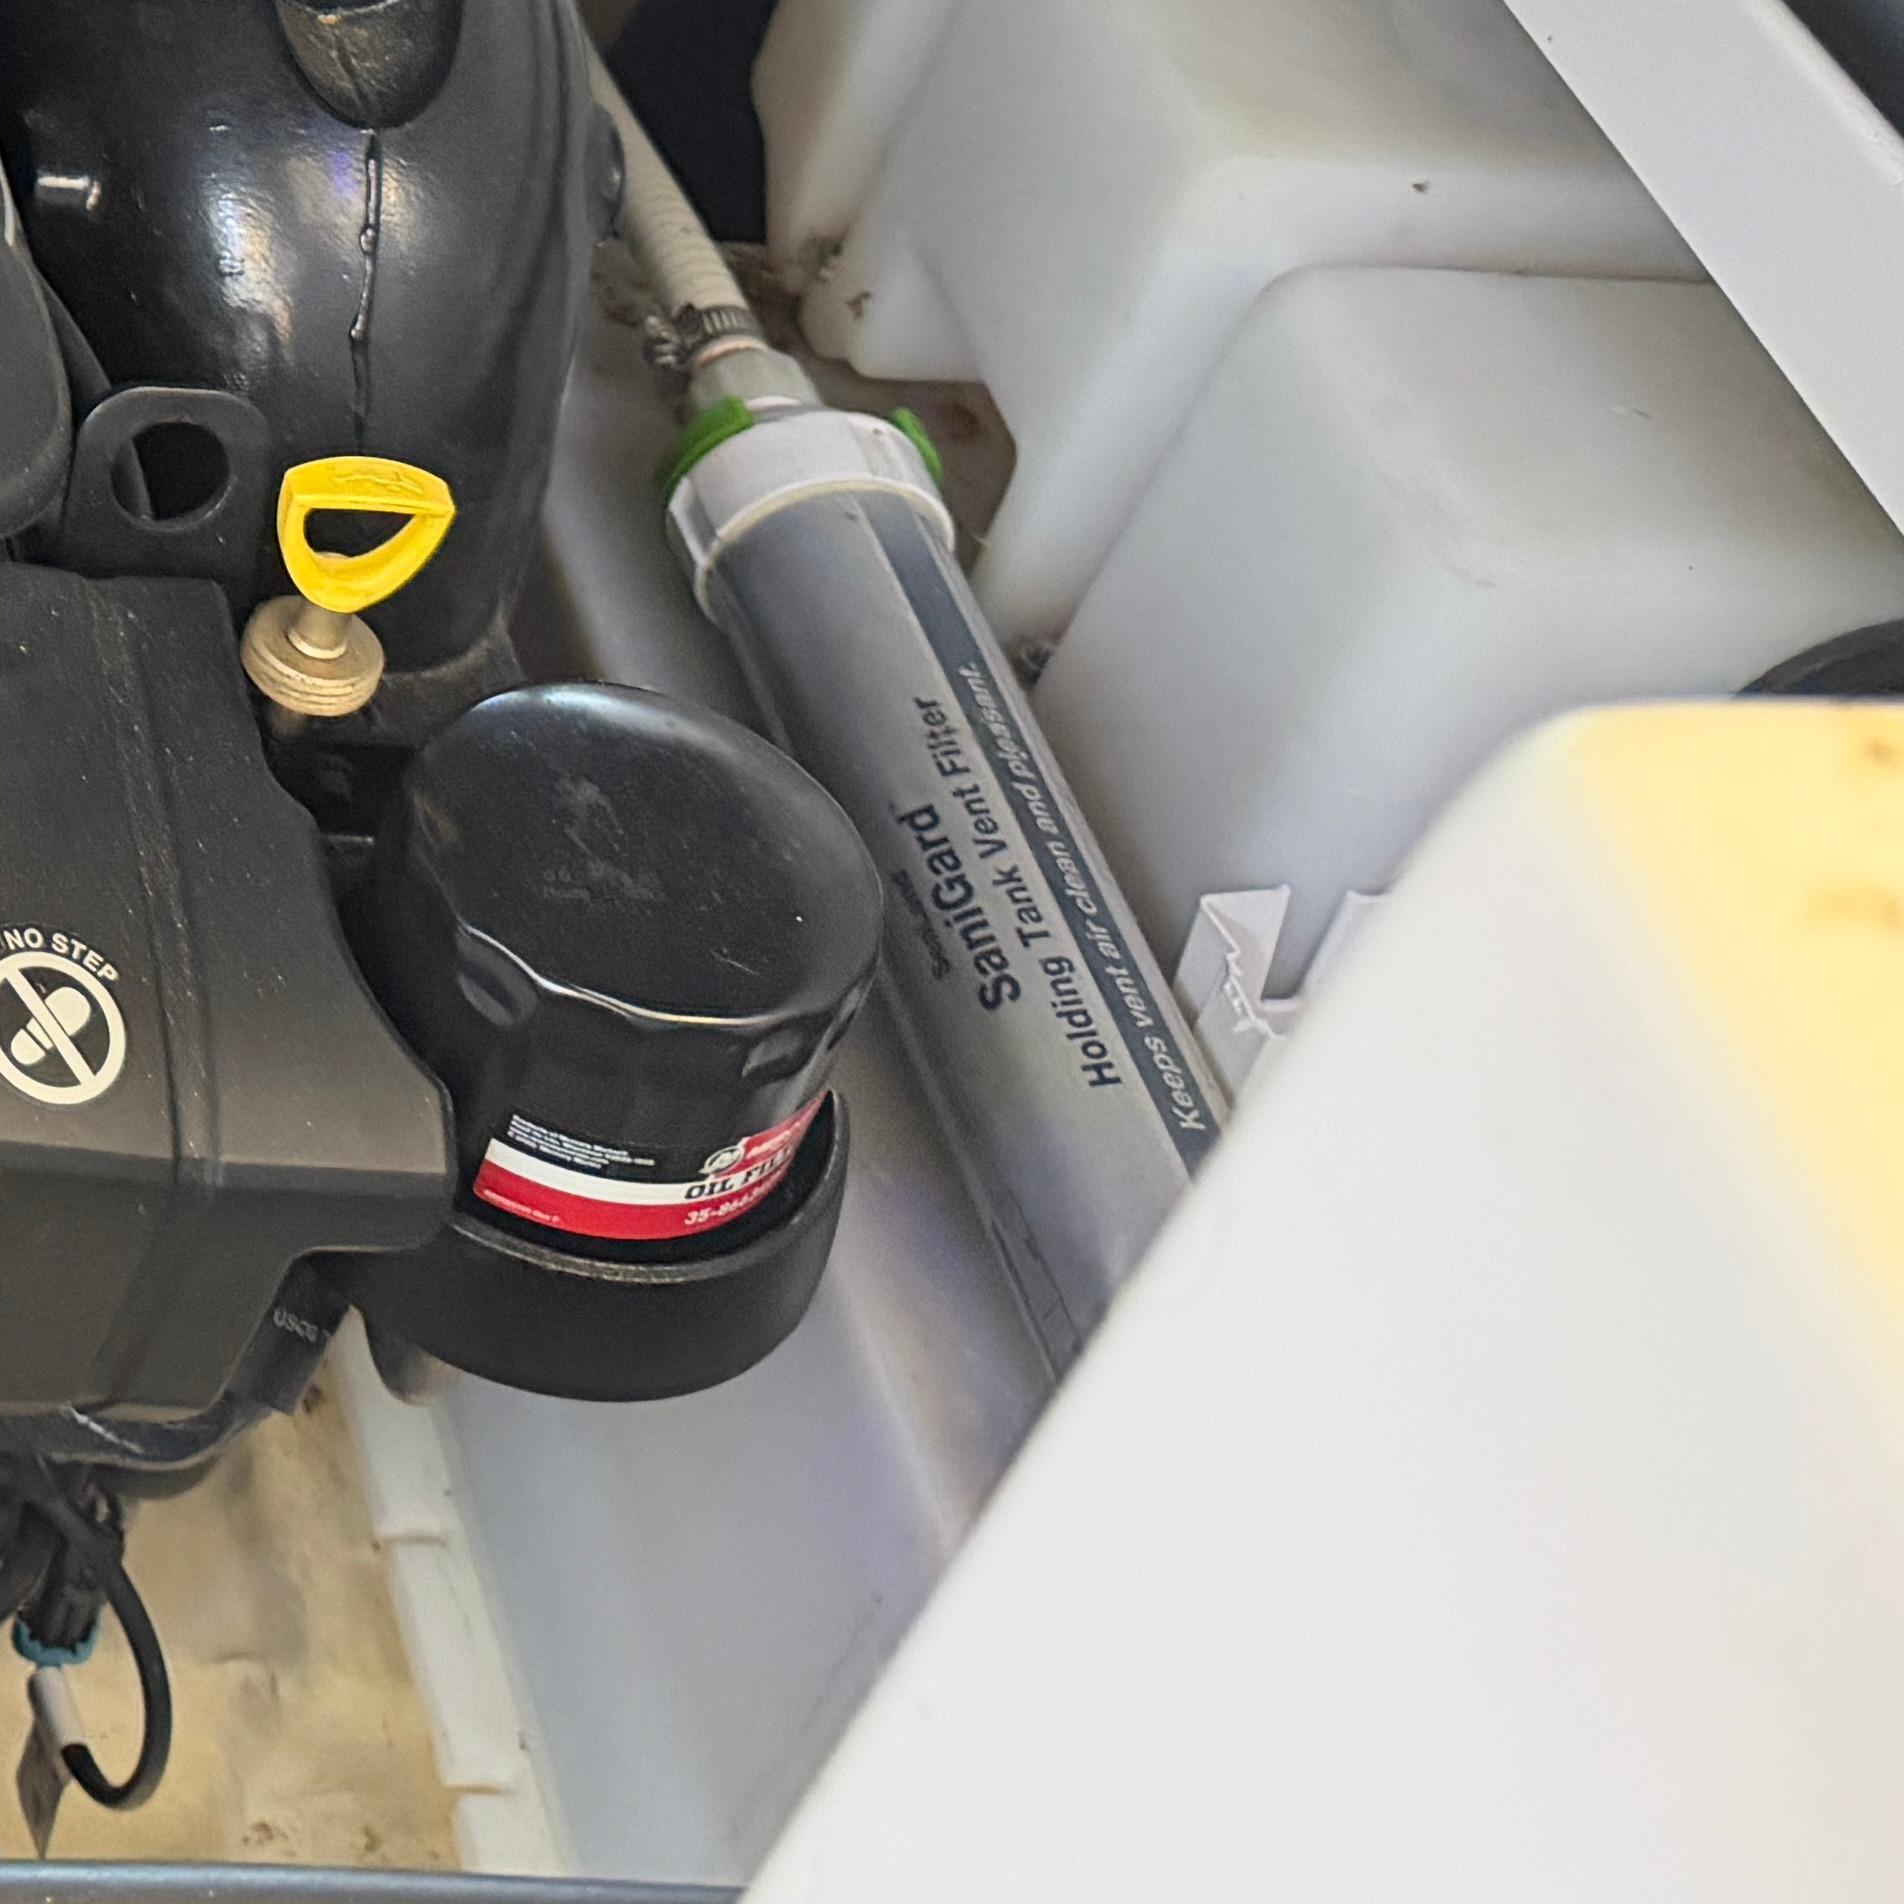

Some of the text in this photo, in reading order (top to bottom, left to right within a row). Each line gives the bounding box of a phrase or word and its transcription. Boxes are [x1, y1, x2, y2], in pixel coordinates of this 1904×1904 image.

[2, 927, 120, 981] NO STEP
[896, 804, 1021, 1011] SaniGard
[913, 696, 1122, 1088] Holding Tank Vent Filter
[959, 661, 1207, 1131] Keeps vent air clean and pleasant.
